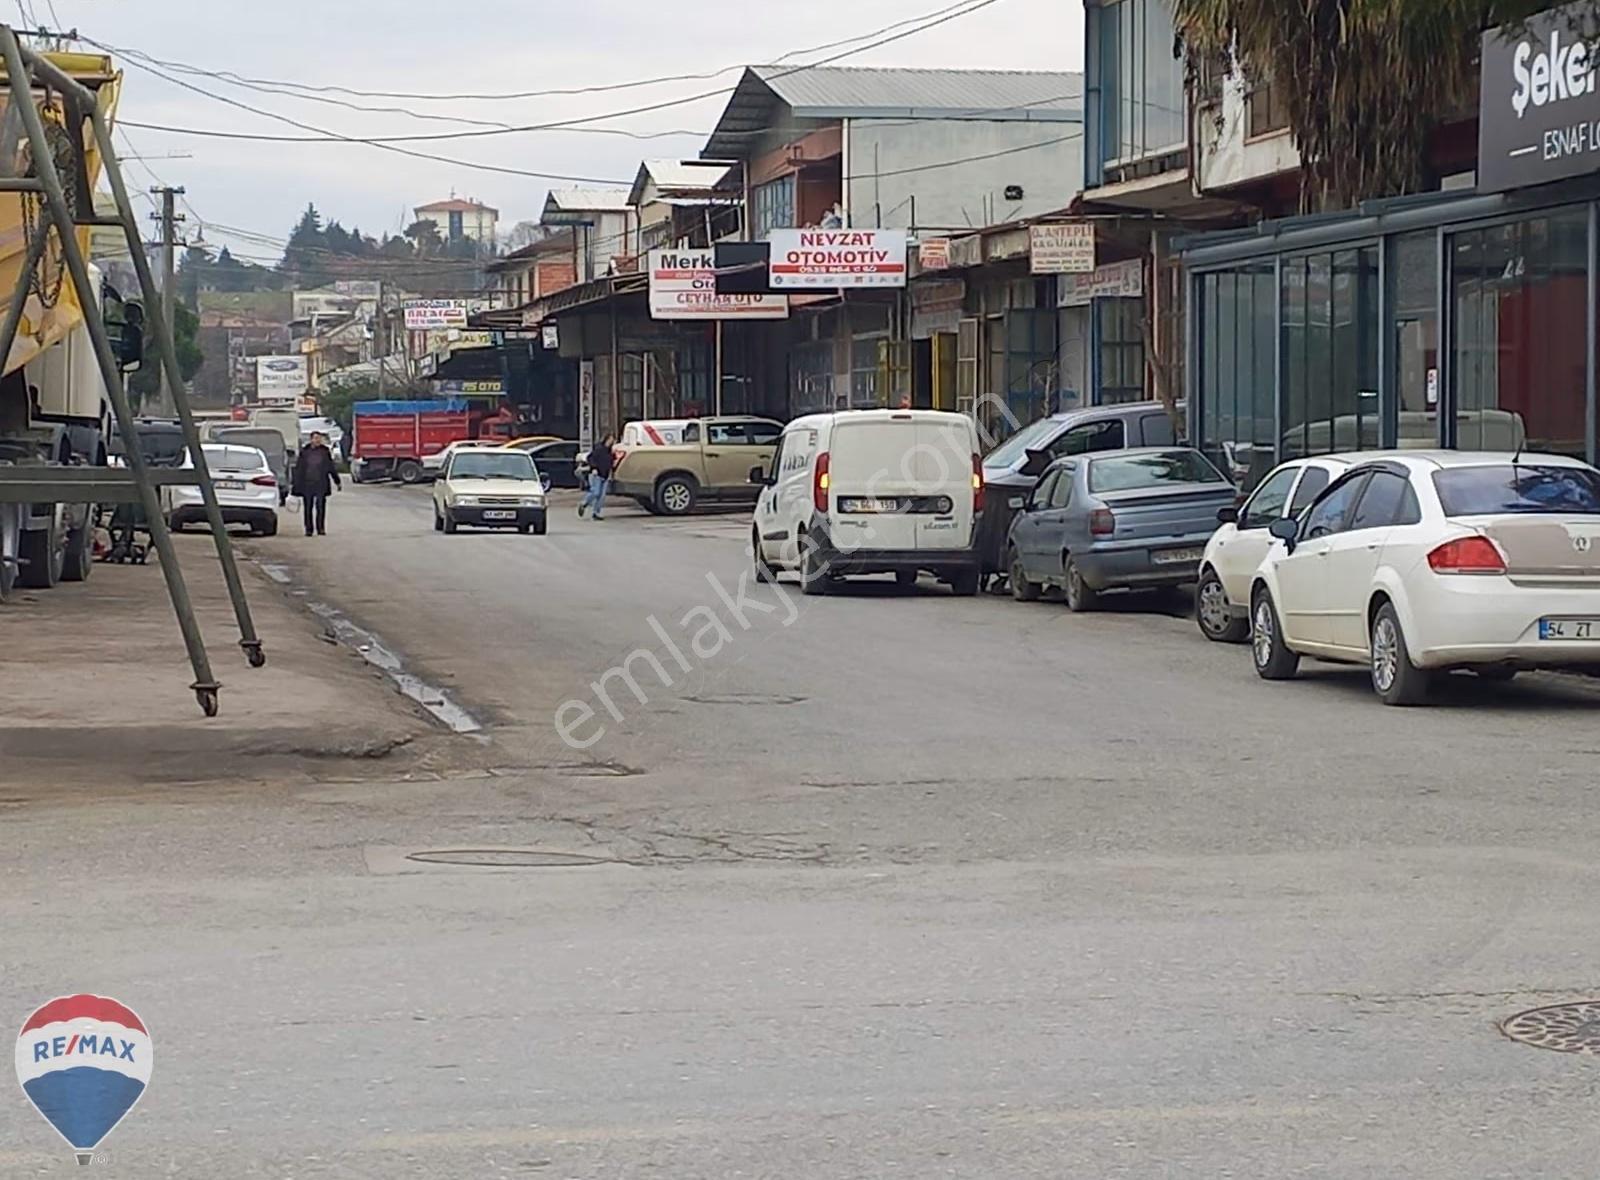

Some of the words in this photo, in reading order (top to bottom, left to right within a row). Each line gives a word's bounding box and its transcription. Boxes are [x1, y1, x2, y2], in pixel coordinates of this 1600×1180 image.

[1544, 123, 1587, 160] ESNAF
[801, 232, 875, 246] NEVZAT
[661, 254, 716, 269] Merk
[787, 247, 888, 265] OTOMOTİV
[1548, 622, 1564, 637] 54
[1576, 622, 1592, 637] ZT
